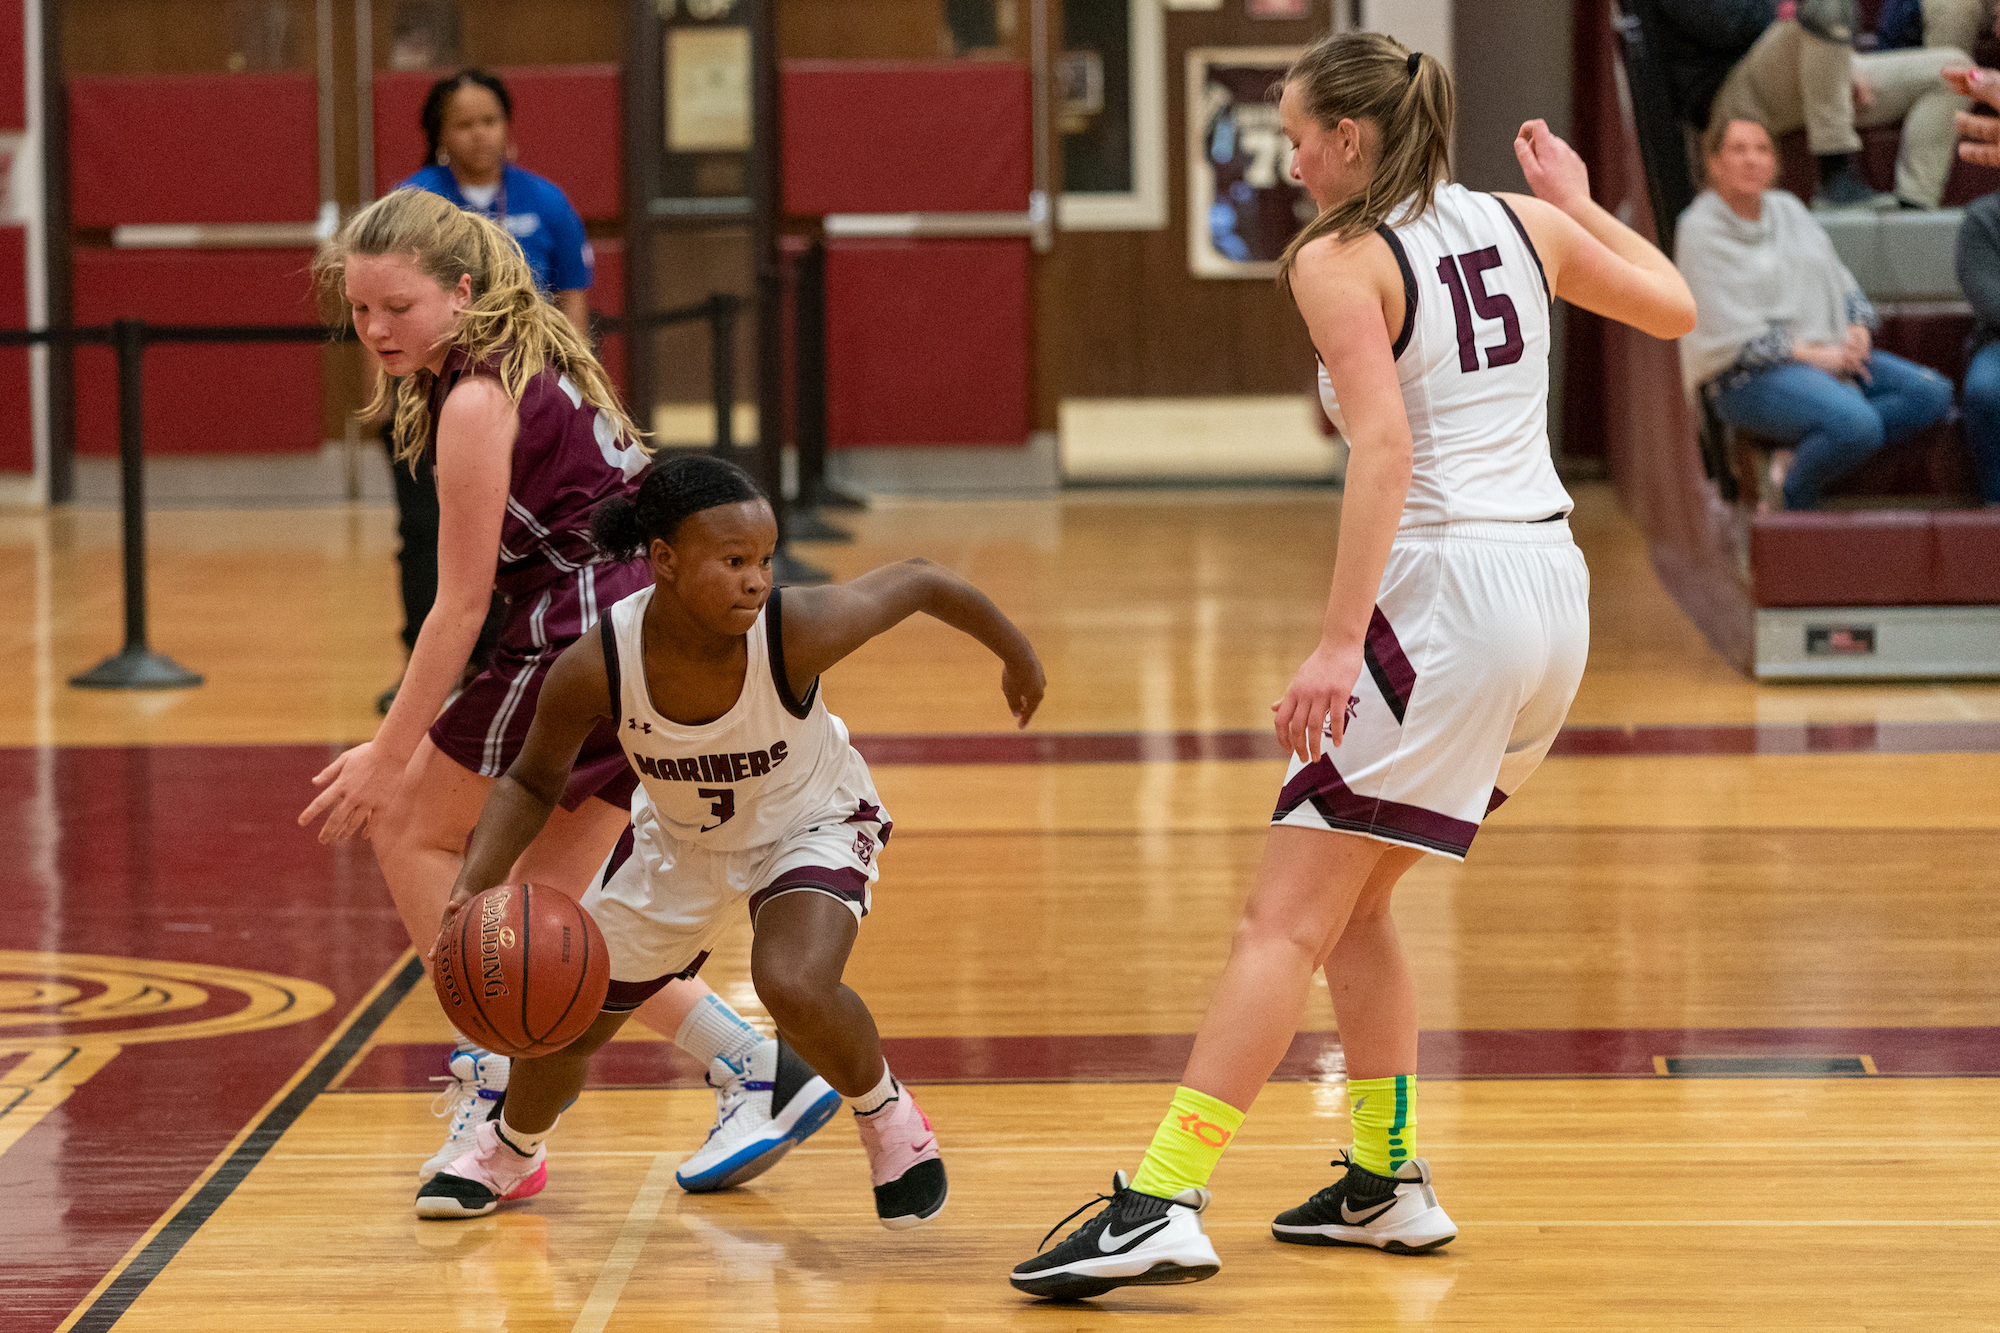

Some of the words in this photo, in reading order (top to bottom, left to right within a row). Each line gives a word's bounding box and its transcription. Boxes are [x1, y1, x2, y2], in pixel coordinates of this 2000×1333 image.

[1437, 245, 1524, 373] 15
[633, 741, 788, 783] MARINERS
[698, 788, 735, 833] 3
[481, 893, 512, 998] SPALDING
